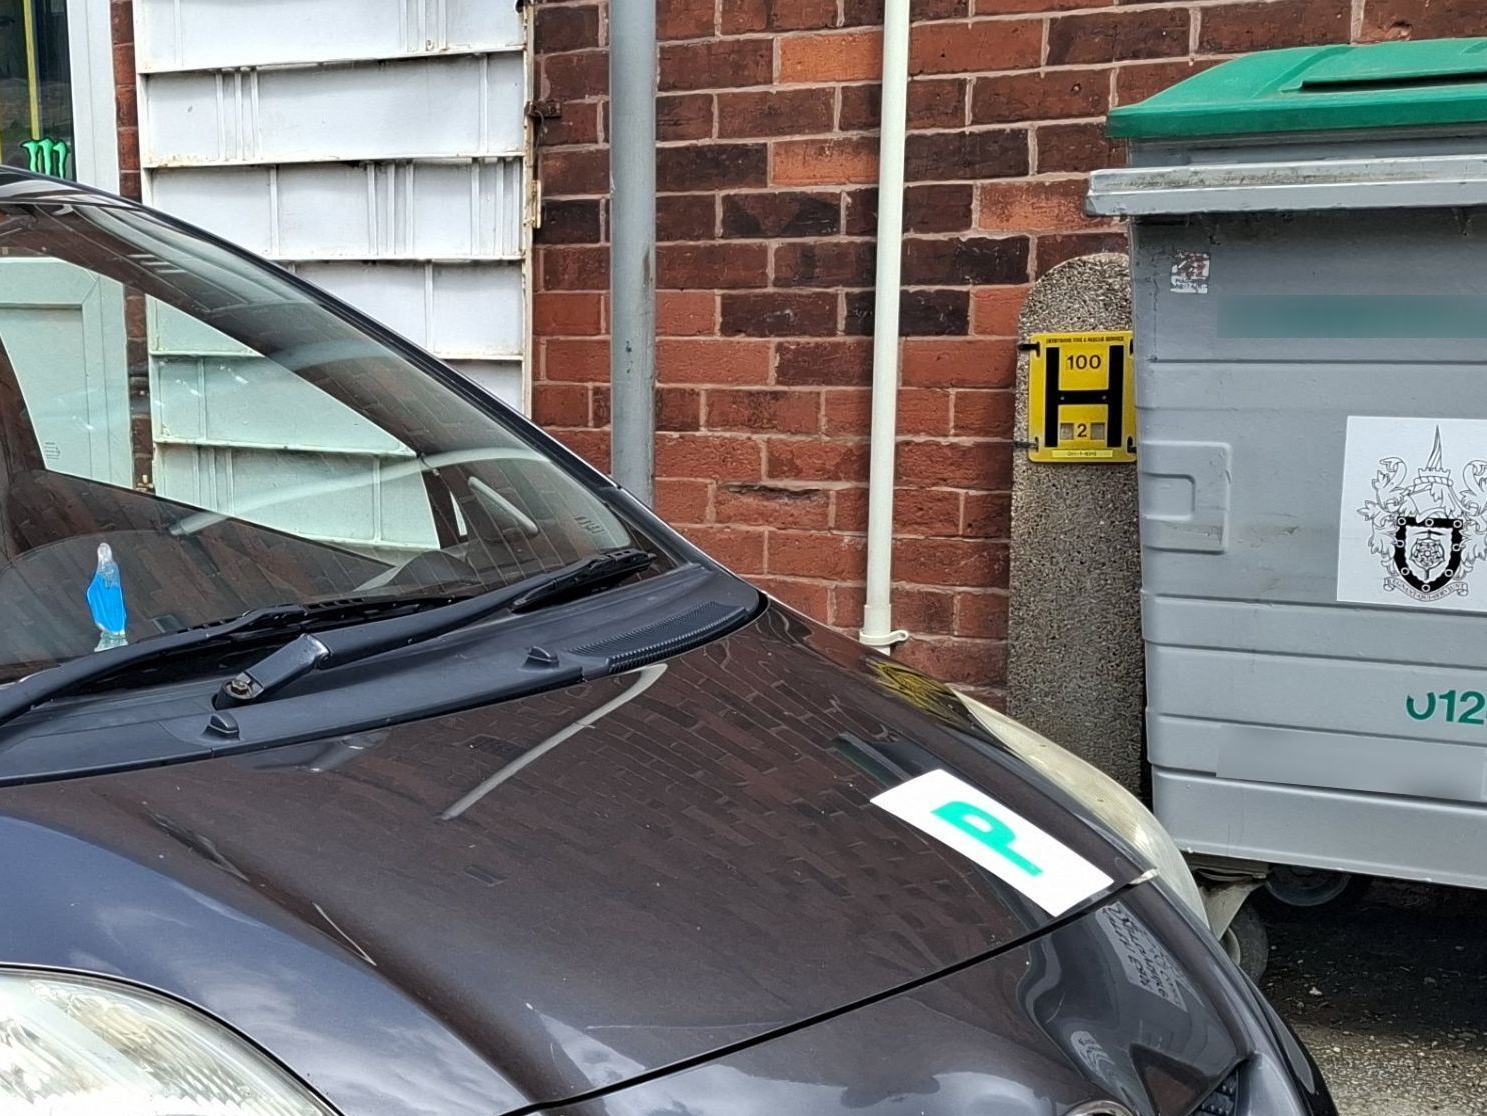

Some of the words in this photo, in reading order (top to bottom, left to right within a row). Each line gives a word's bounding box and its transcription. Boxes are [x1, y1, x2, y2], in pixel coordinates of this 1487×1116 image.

[1066, 354, 1102, 370] 100
[1044, 345, 1124, 448] H
[1077, 423, 1088, 438] 2
[930, 801, 1044, 877] P
